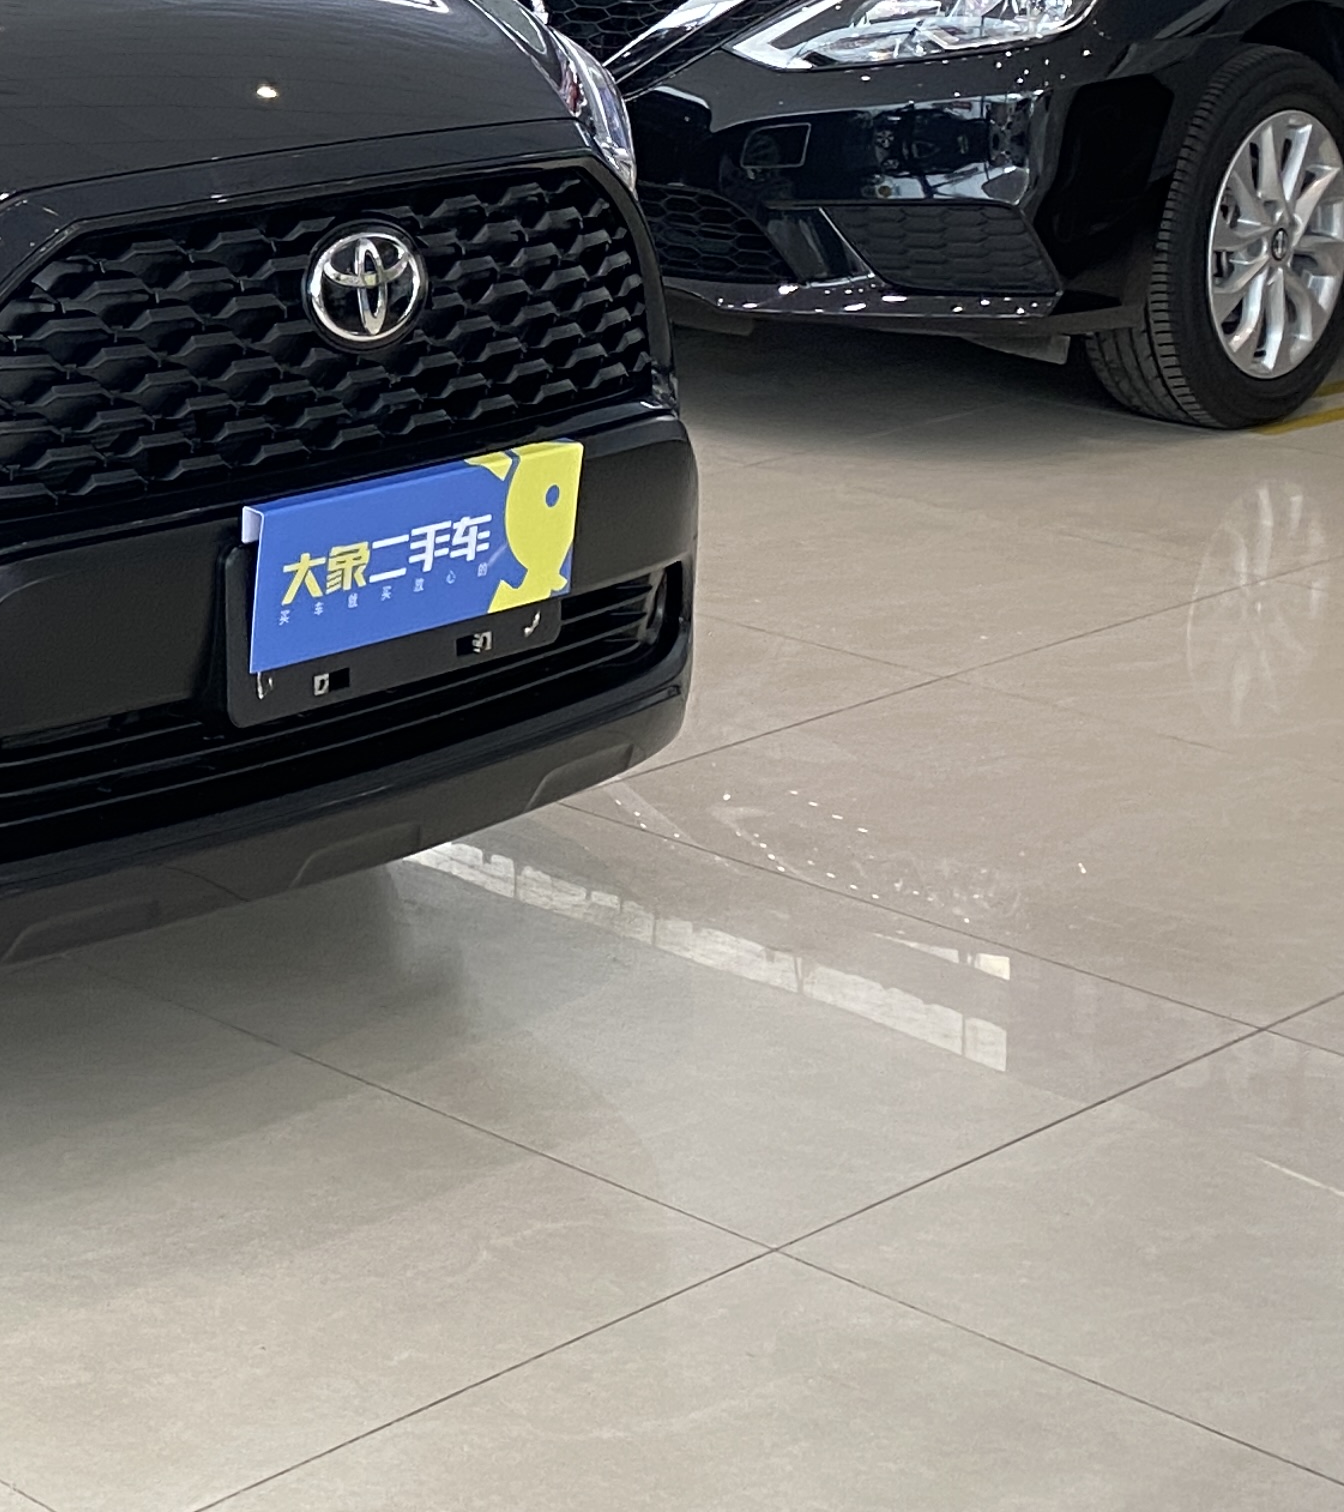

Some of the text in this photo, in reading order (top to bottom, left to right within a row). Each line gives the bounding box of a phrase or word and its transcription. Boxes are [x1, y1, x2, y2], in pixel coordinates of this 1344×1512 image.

[278, 563, 489, 626] 买车就买放心的
[282, 514, 493, 605] 大象二手车
